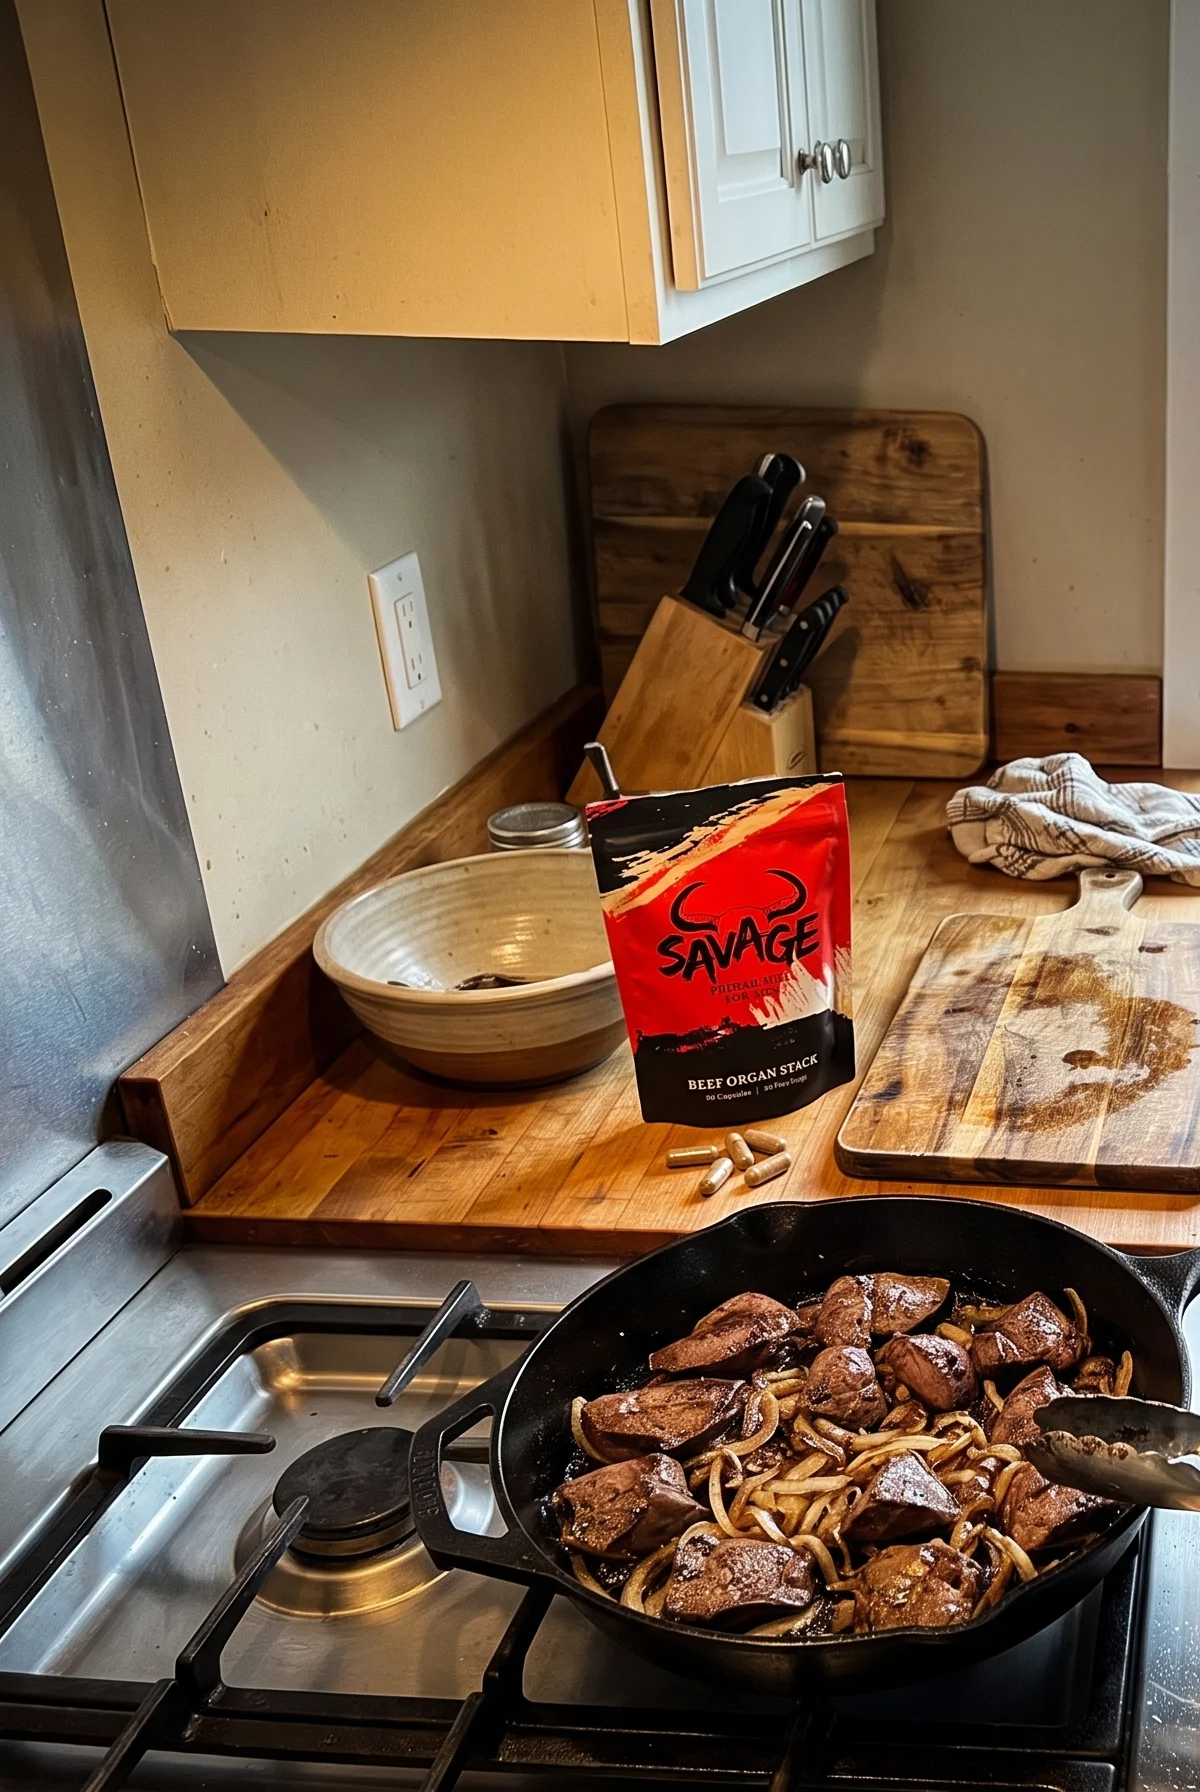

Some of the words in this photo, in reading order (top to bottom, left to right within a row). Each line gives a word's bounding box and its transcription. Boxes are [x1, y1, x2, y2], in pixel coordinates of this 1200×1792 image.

[657, 912, 820, 985] SAVAGE
[687, 1078, 724, 1091] BEEF
[726, 1067, 777, 1087] ORGAN
[779, 1053, 818, 1076] STACK
